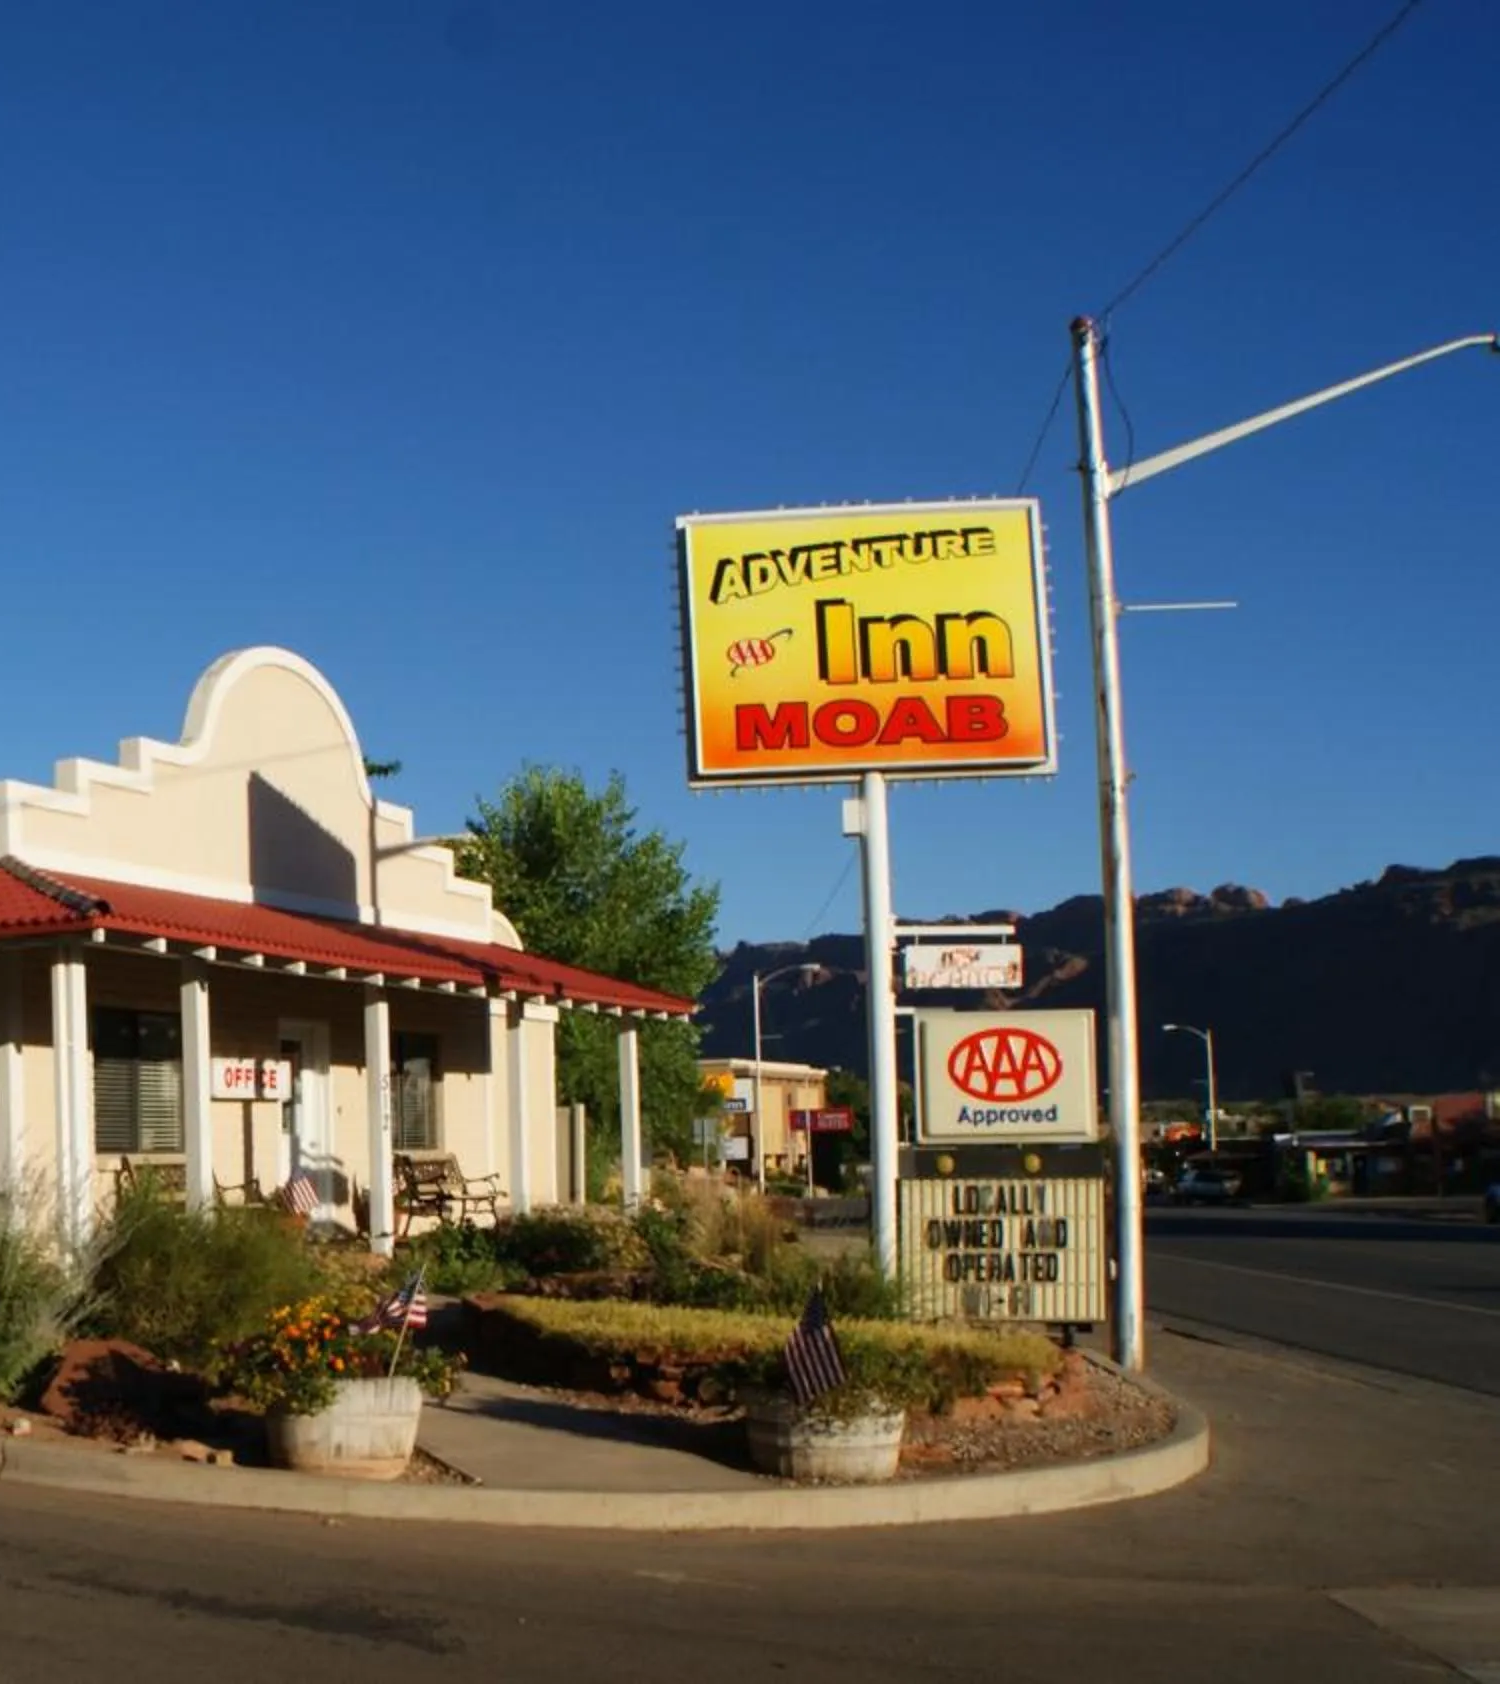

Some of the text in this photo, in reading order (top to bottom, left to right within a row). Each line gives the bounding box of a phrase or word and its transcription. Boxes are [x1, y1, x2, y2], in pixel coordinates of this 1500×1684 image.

[709, 527, 997, 605] ADVENTURE
[815, 598, 1015, 684] Inn
[735, 694, 1010, 752] MOAB
[223, 1066, 278, 1090] OFFCE
[955, 1031, 1056, 1099] AAA
[957, 1104, 1058, 1127] Approved
[954, 1184, 1047, 1215] LOCALLY
[927, 1219, 1068, 1250] OWNED AND
[945, 1253, 1059, 1283] OPERATED
